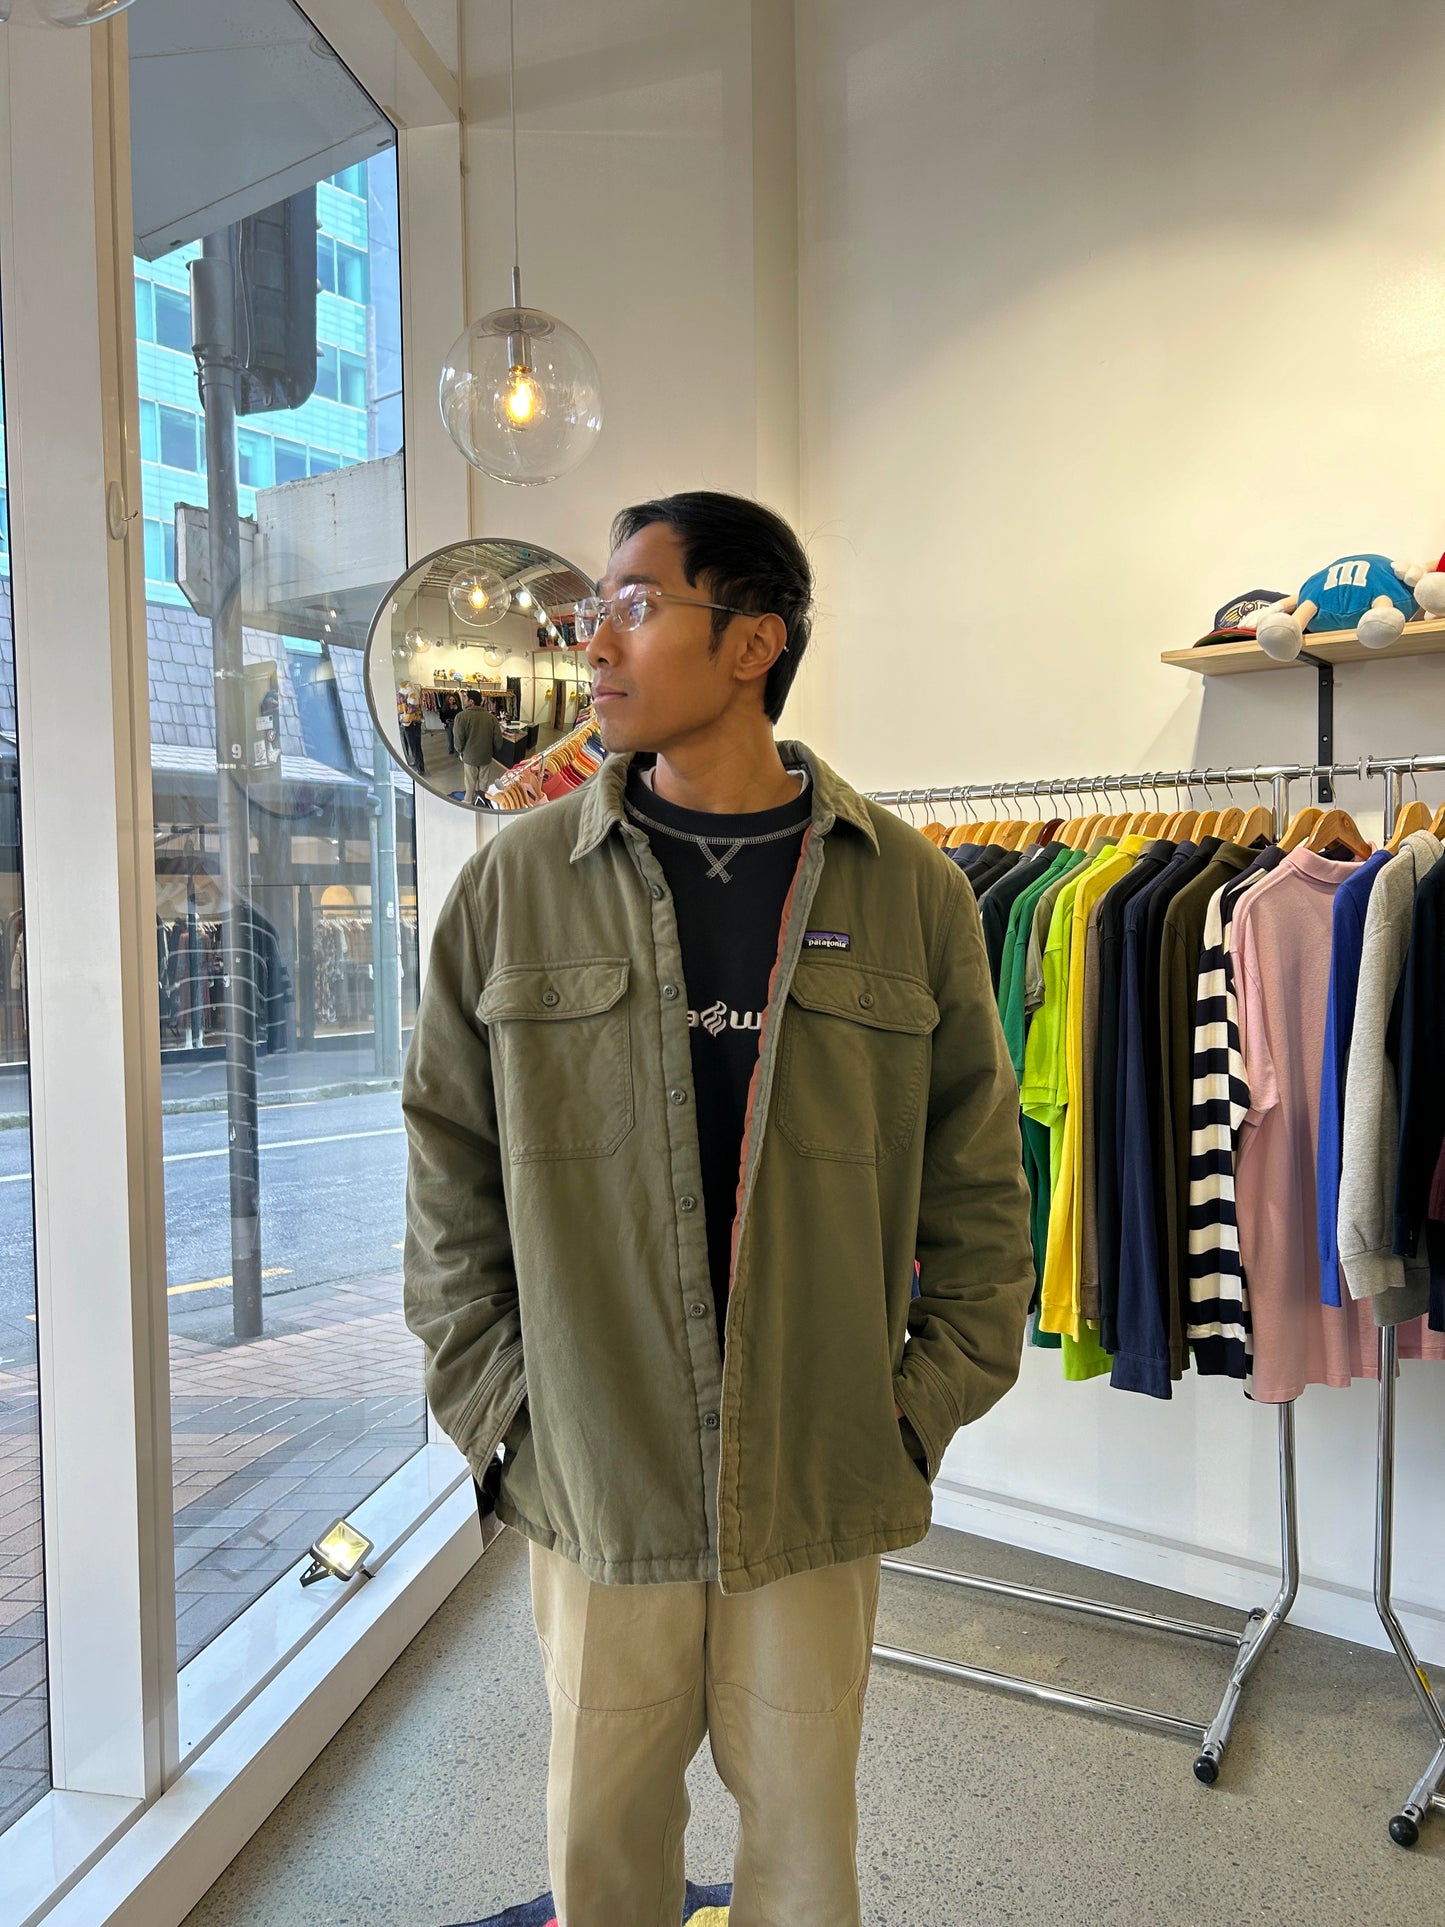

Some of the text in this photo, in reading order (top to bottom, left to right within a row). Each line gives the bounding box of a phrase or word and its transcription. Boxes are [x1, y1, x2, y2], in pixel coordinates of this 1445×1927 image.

[1324, 560, 1371, 590] m
[231, 744, 242, 759] 9
[808, 939, 846, 948] patagonia
